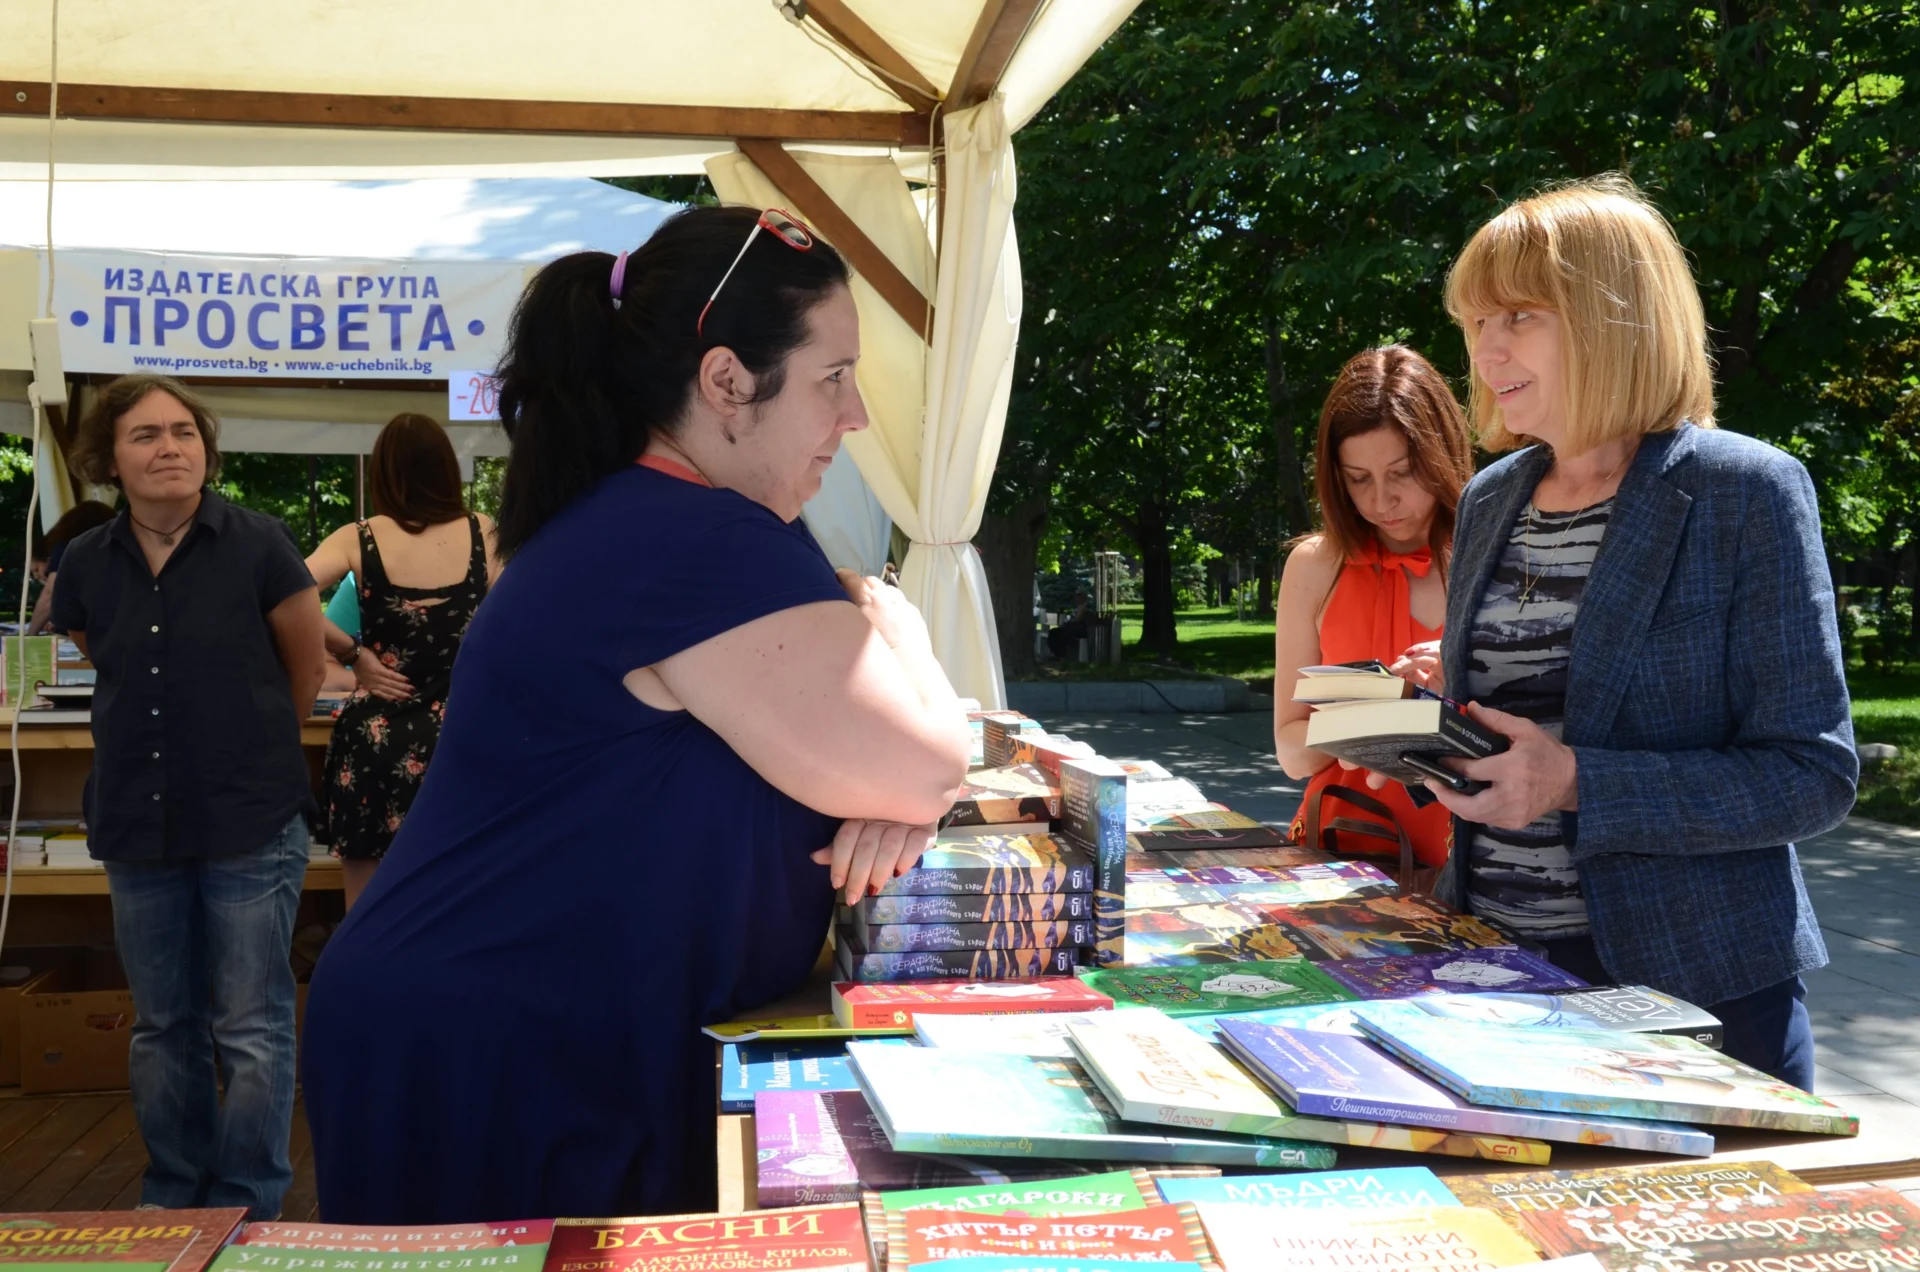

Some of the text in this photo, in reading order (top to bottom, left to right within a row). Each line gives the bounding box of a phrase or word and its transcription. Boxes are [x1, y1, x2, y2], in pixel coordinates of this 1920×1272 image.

[104, 268, 440, 299] ИЗДАТЕЛСКА ГРУПА
[103, 296, 456, 352] ПРОСВЕТА
[133, 355, 433, 374] www.prosveta.bg www.e-uchebnik.bg
[904, 870, 958, 887] СЕРАФИНА
[903, 898, 957, 915] СЕРАФИНА
[907, 926, 961, 943] СЕРАФИНА
[890, 954, 944, 973] СЕРАФИНА
[1158, 1107, 1213, 1128] Палечка
[1330, 1098, 1458, 1124] Лешникотрошачката
[1224, 1175, 1384, 1200] МЪДРИ
[1491, 1169, 1760, 1195] ДВАНАЙСЕТ ТАНЦУВАЩИ
[1499, 1180, 1783, 1212] ПРИНЦЕСИ
[259, 1226, 529, 1242] Упражнителна
[590, 1213, 825, 1250] БАСНИ
[915, 1222, 1174, 1241] ХИТЪР ПЕТЪР
[1577, 1211, 1903, 1252] Червенорозка
[1038, 1240, 1057, 1250] И
[237, 1252, 520, 1270] Упражнителна
[622, 1258, 794, 1272] МИХАЙЛОВСКИ
[631, 1250, 754, 1267] ЛАФОНТЕН,
[766, 1247, 853, 1260] КРИЛОВ,
